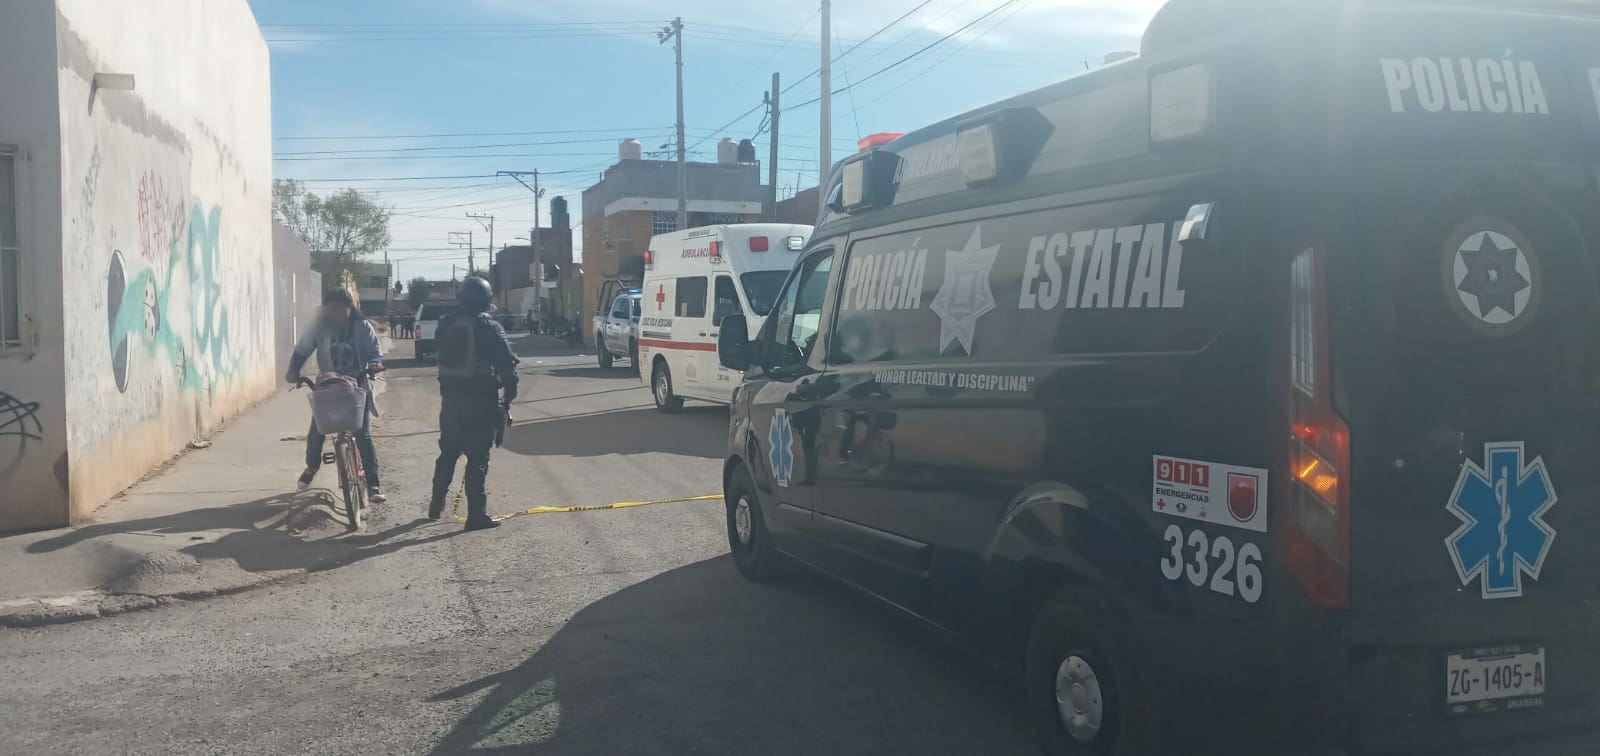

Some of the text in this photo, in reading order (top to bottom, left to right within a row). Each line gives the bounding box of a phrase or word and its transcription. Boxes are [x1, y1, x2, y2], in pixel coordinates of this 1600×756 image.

[1380, 48, 1550, 114] POLICÍA
[842, 220, 1186, 311] POLICÍA ESTATAL
[906, 370, 948, 386] LEALTAD
[948, 372, 956, 387] Y
[1158, 461, 1206, 485] 911
[1156, 487, 1209, 503] EMERGENCIAS
[1160, 524, 1263, 603] 3326
[1450, 661, 1543, 696] ZG-1405-A
